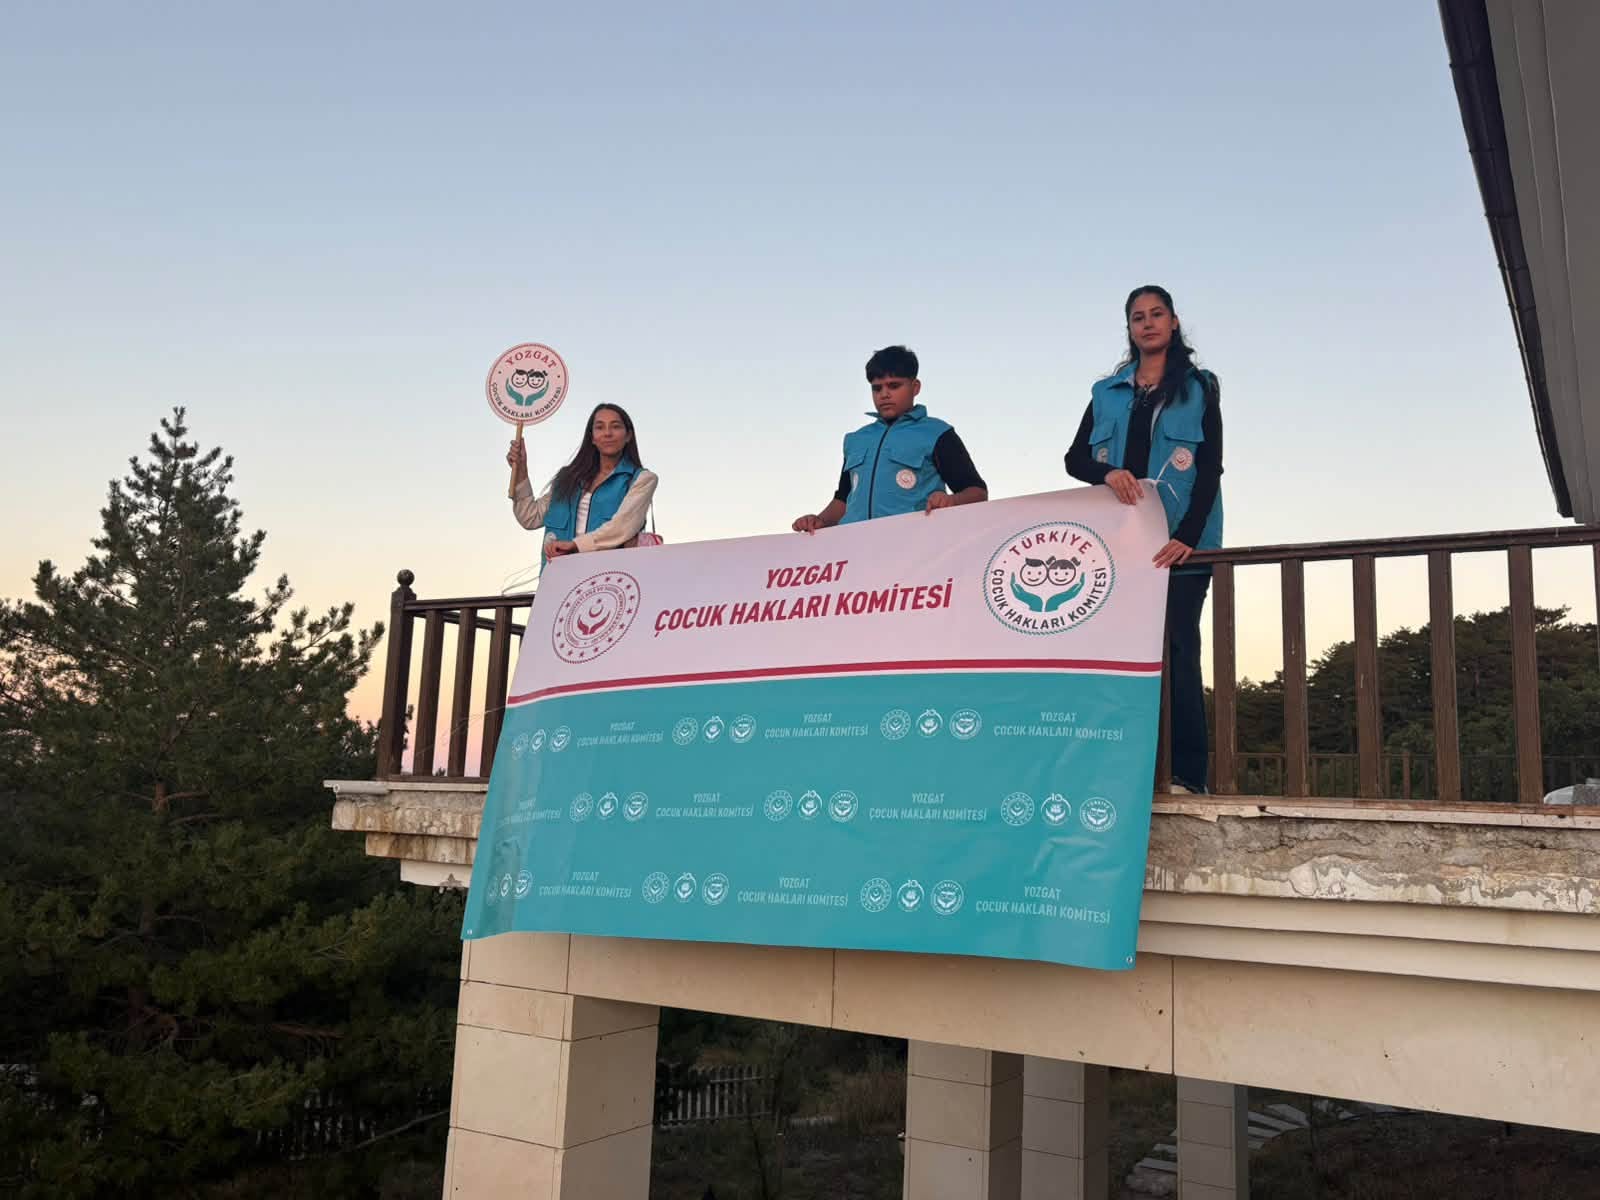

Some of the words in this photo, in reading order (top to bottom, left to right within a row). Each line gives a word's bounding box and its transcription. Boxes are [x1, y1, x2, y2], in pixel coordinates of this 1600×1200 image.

[505, 350, 557, 368] YOZGAT
[1009, 529, 1093, 555] TÜRKİYE
[766, 560, 848, 589] YOZGAT
[990, 568, 1009, 610] ÇOCUK
[1004, 608, 1066, 630] HAKLARI
[1067, 566, 1107, 622] KOMİTESİ
[654, 602, 727, 638] ÇOCUK
[729, 594, 831, 625] HAKLARI
[834, 578, 953, 615] KOMİTESİ
[803, 712, 832, 723] YOZGAT
[1040, 711, 1076, 723] YOZGAT
[792, 727, 829, 737] HAKLARI
[1028, 726, 1072, 737] HAKLARI
[912, 792, 944, 804] YOZGAT
[779, 877, 811, 889] YOZGAT
[1024, 886, 1062, 900] YOZGAT
[1011, 902, 1057, 917] HAKLARI
[1060, 905, 1111, 924] KOMİTESİ
